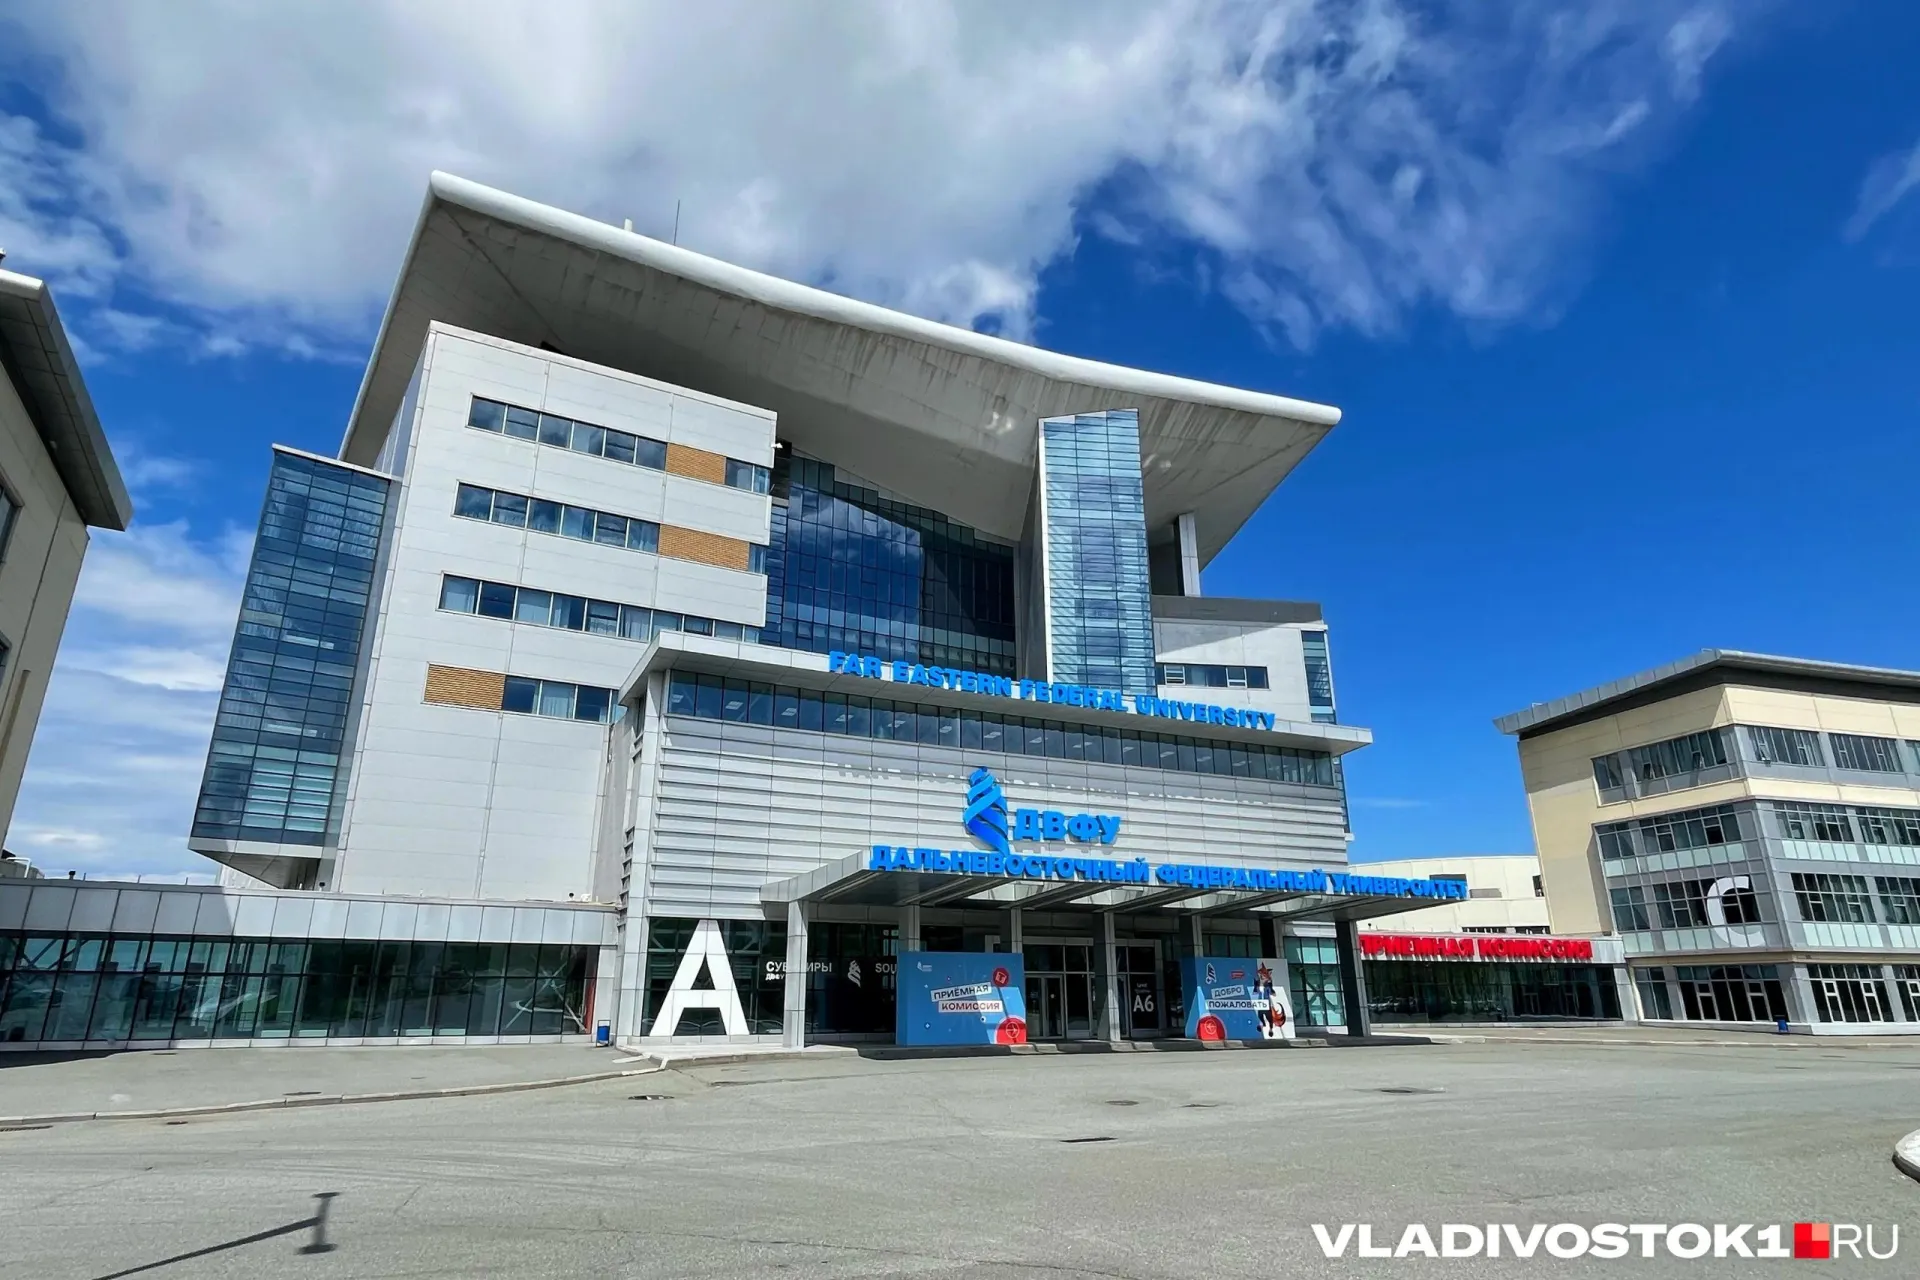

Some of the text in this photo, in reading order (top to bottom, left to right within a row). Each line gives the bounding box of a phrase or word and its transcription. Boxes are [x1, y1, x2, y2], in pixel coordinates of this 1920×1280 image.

[828, 650, 1276, 732] FAR EASTERN FEDERAL UNIVERSITY
[1012, 808, 1121, 845] ДВФУ
[869, 845, 1467, 898] ДАЛЬНЕВОСТОЧНЫЙ ФЕДЕРАЛЬНЫЙ УНИВЕРСИТЕТ
[1477, 938, 1593, 960] КОМИССИЯ
[766, 961, 832, 973] СУВИРЫ
[933, 984, 989, 1000] ПРИЁМНАЯ
[1214, 986, 1243, 998] ДОБРО
[941, 1002, 1000, 1011] КОМИССИЯ
[1133, 994, 1155, 1012] A6
[1208, 1000, 1268, 1009] ПОЖАЛОВАТЬ
